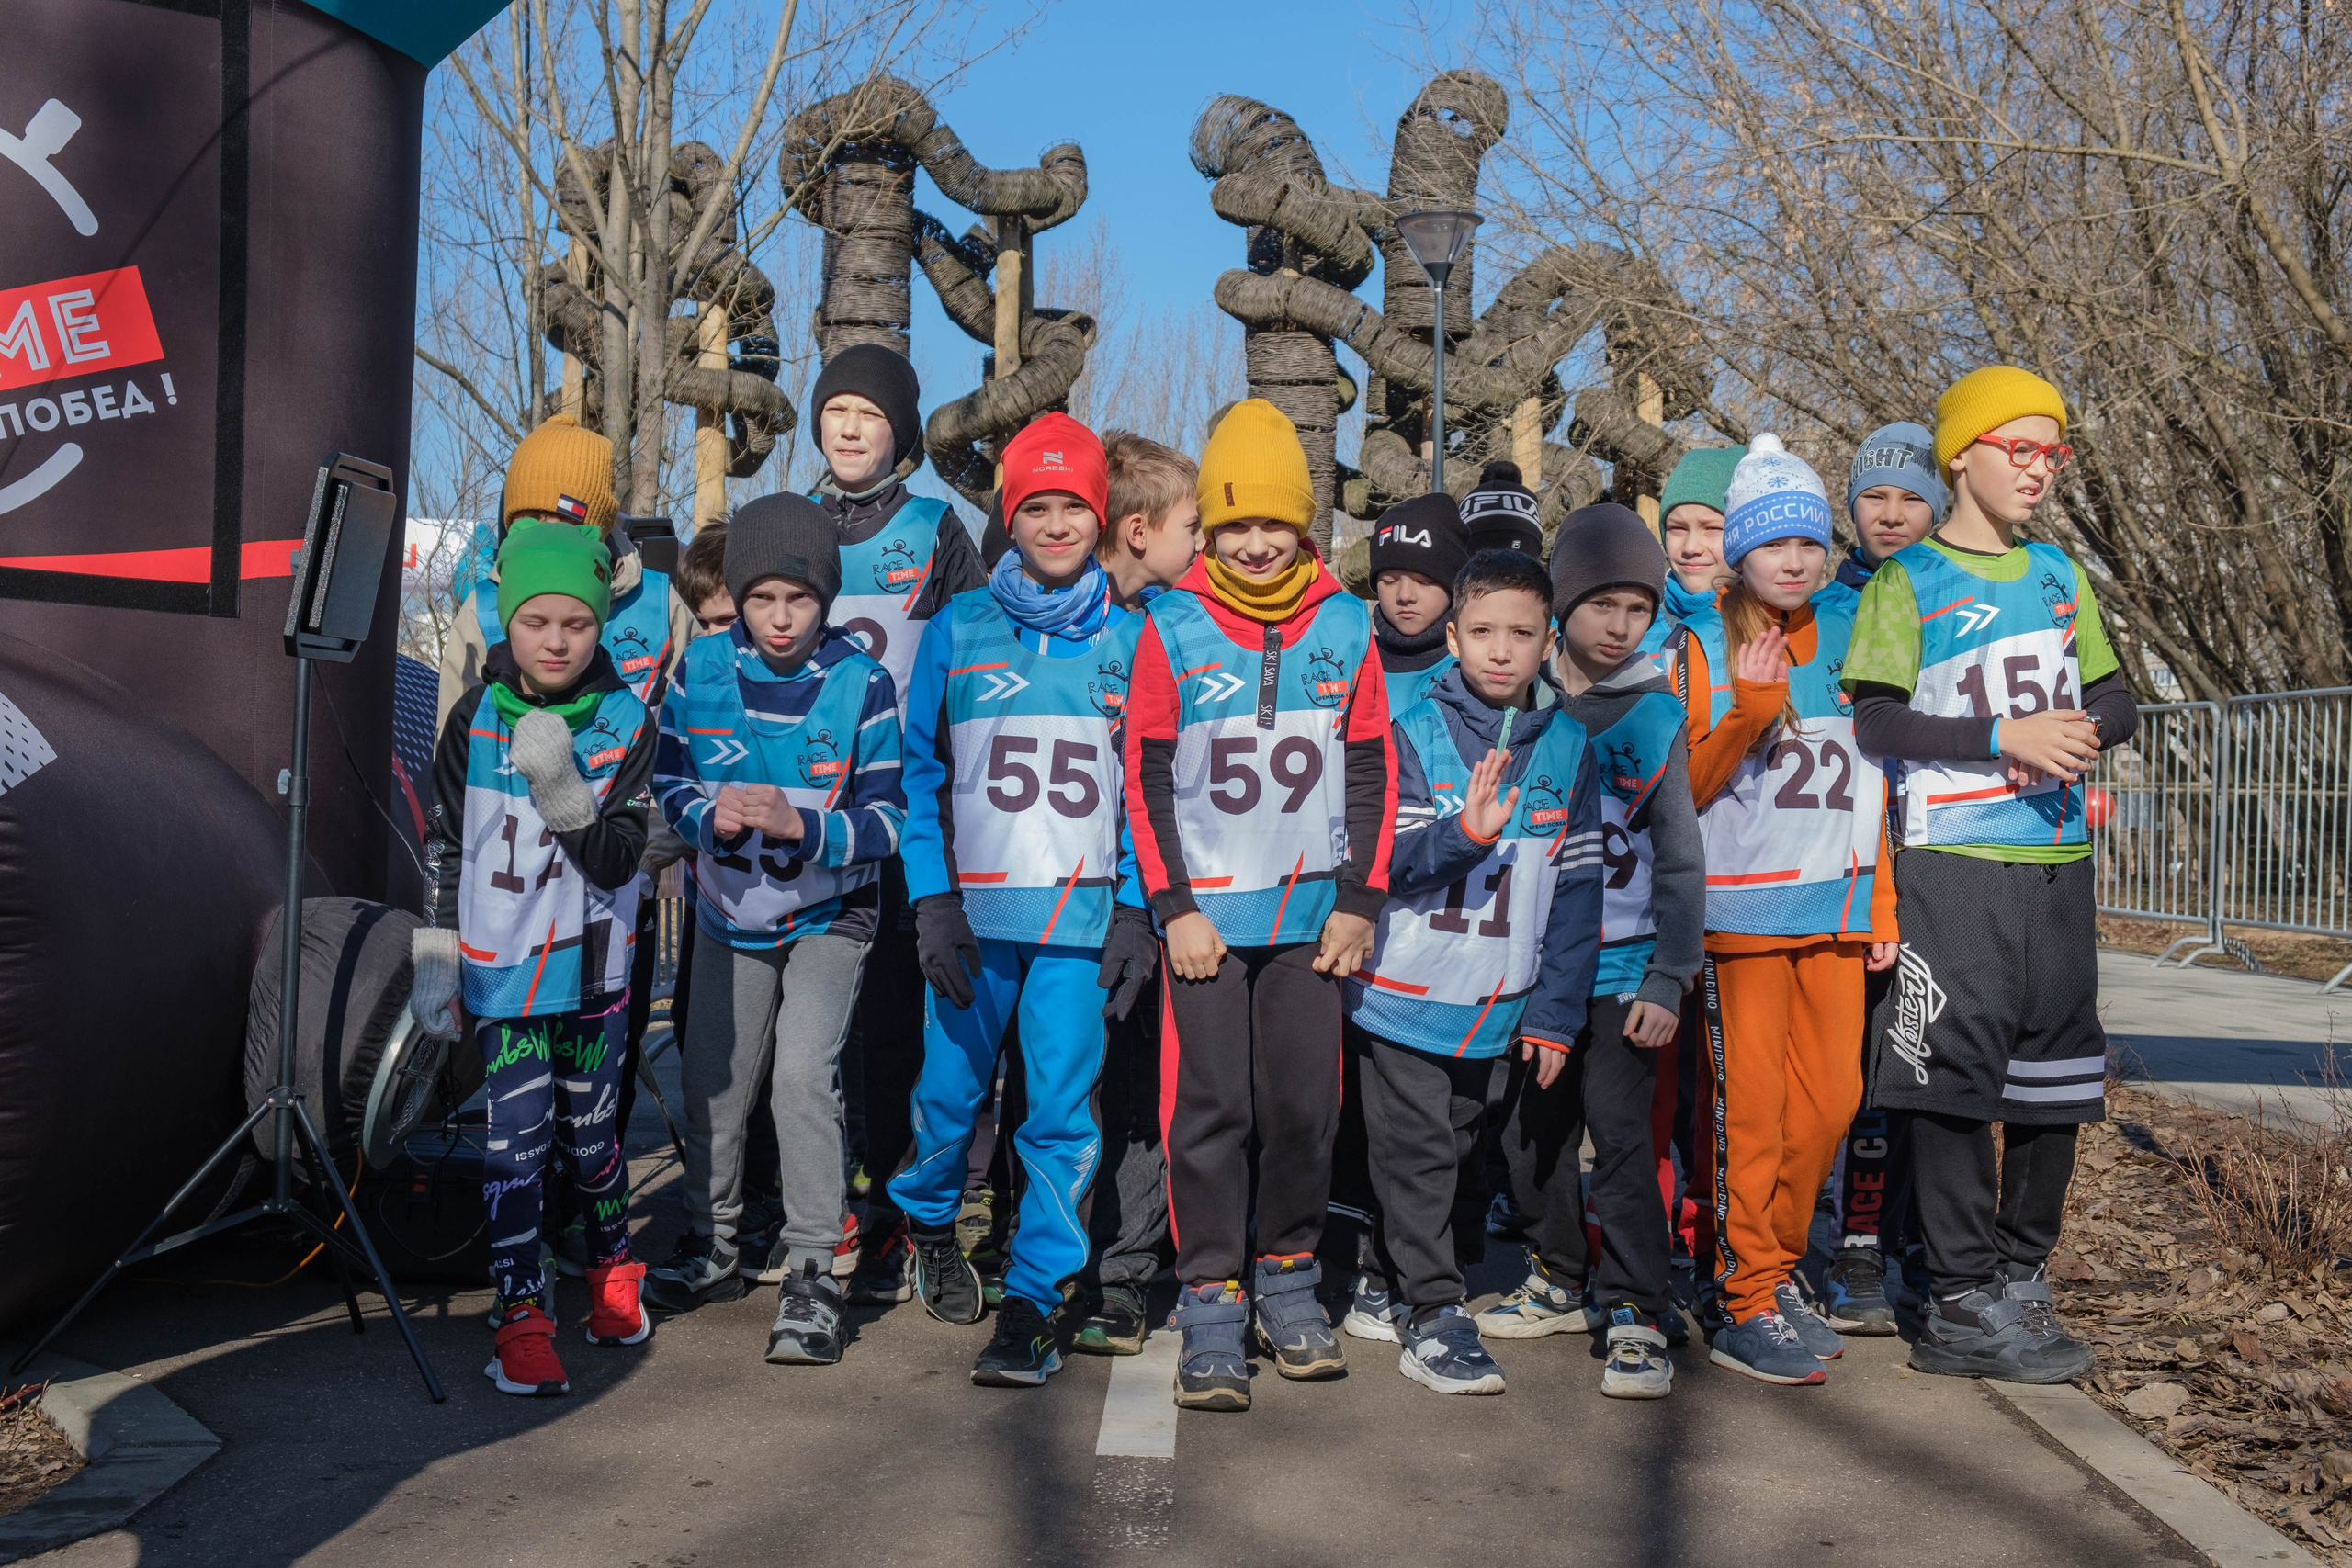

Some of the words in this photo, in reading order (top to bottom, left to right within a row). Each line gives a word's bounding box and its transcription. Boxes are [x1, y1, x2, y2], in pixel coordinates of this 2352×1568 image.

[1032, 465, 1074, 473] NORDSKI
[1744, 502, 1825, 534] РОССИИ
[1379, 525, 1432, 548] FILA
[872, 560, 904, 574] RACE
[890, 569, 915, 581] TIME
[613, 648, 639, 664] ACE
[625, 657, 650, 671] TIME
[1301, 670, 1332, 685] RACE
[1087, 682, 1119, 695] RACE
[581, 740, 607, 759] ACE
[593, 749, 621, 765] TIME
[797, 751, 827, 766] RACE
[813, 762, 837, 774] TIME
[986, 734, 1100, 819] 55
[1209, 735, 1323, 816] 59
[1766, 739, 1854, 812] 22
[1534, 810, 1563, 822] TIME
[1704, 953, 1718, 1010] MINIDINO
[1710, 1026, 1725, 1081] MINIDINO
[1714, 1097, 1726, 1151] MINIDINO
[514, 1143, 547, 1162] DASSI
[571, 1141, 605, 1157] GOOD
[1716, 1167, 1727, 1221] MINIDINO
[1717, 1236, 1736, 1282] MINIDINO
